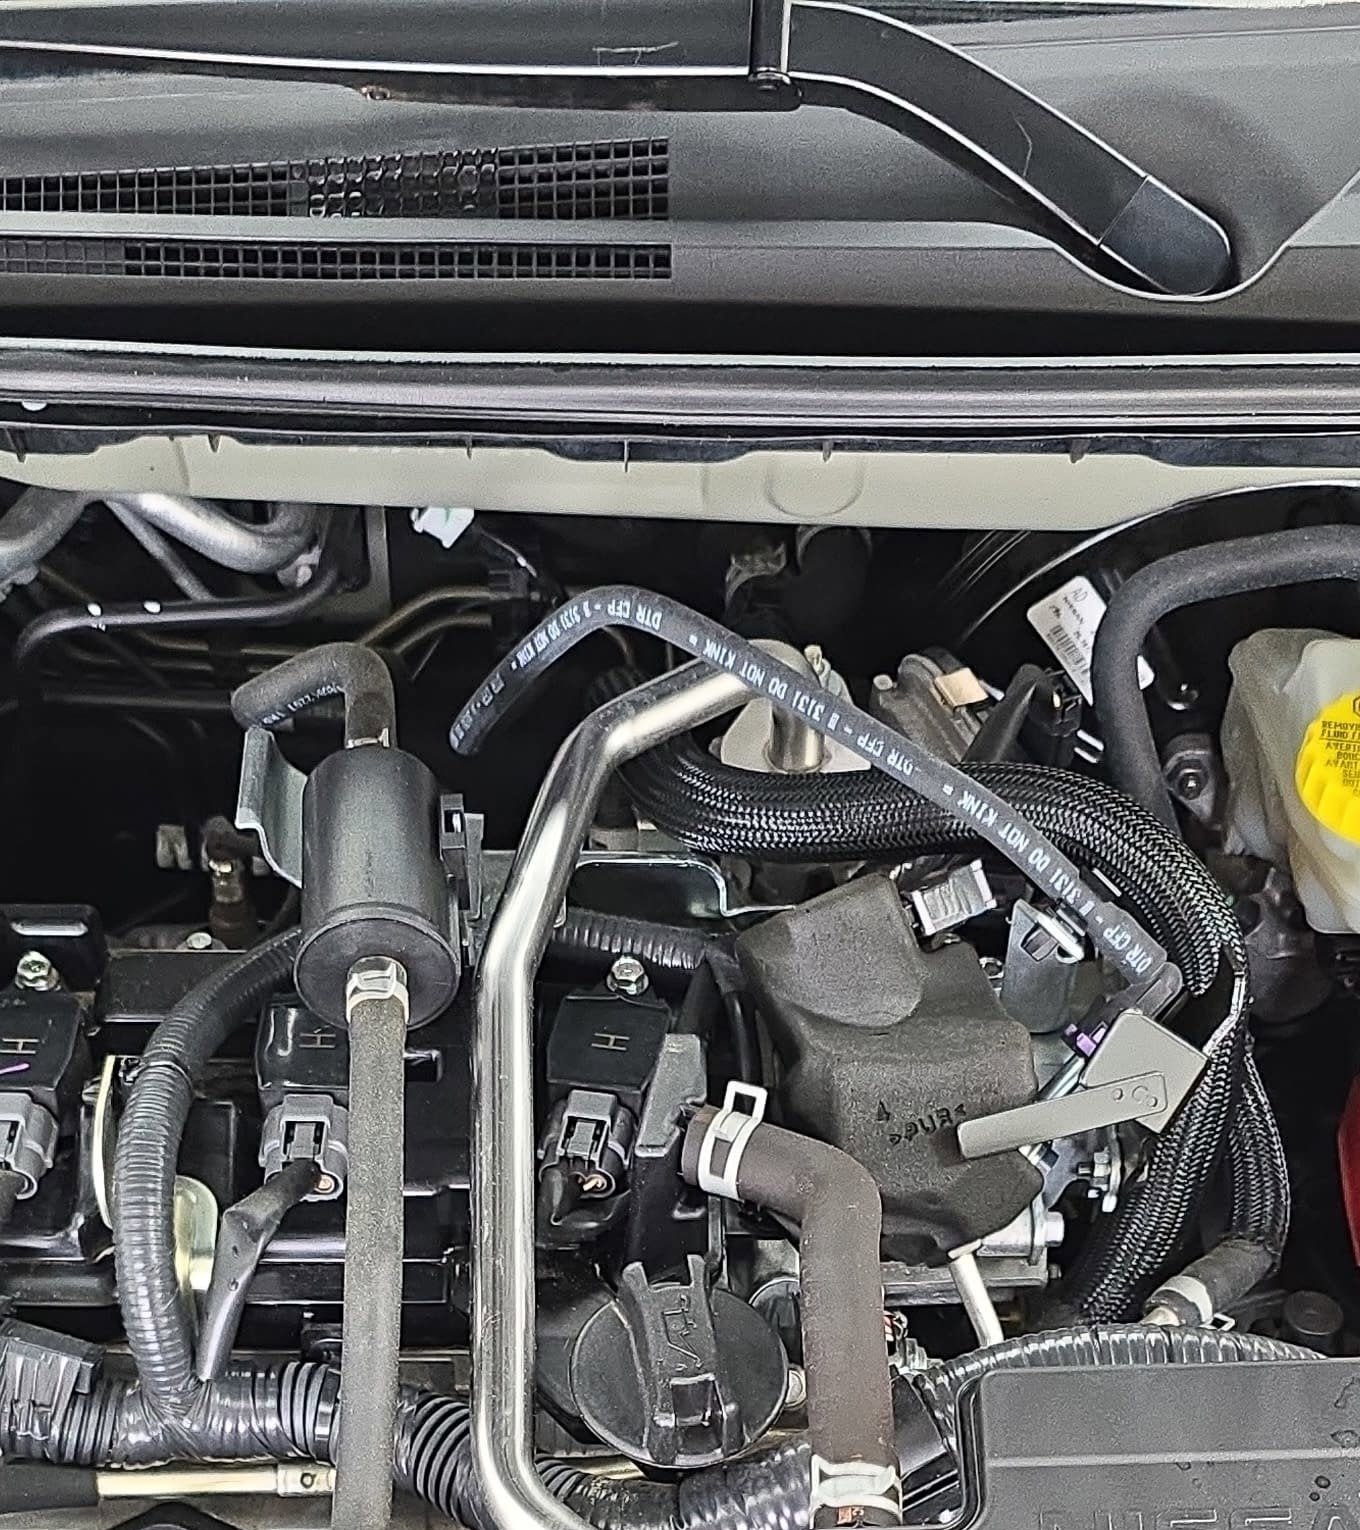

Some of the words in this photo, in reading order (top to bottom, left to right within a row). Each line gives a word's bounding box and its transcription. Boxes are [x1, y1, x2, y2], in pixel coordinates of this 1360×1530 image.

[636, 603, 663, 631] DTR
[703, 638, 736, 669] KINK
[740, 661, 767, 688] NOT
[769, 677, 788, 699] DO
[1321, 729, 1348, 740] FLUID
[887, 754, 914, 776] DTR
[957, 790, 999, 828] KINK
[998, 822, 1031, 853] NOT
